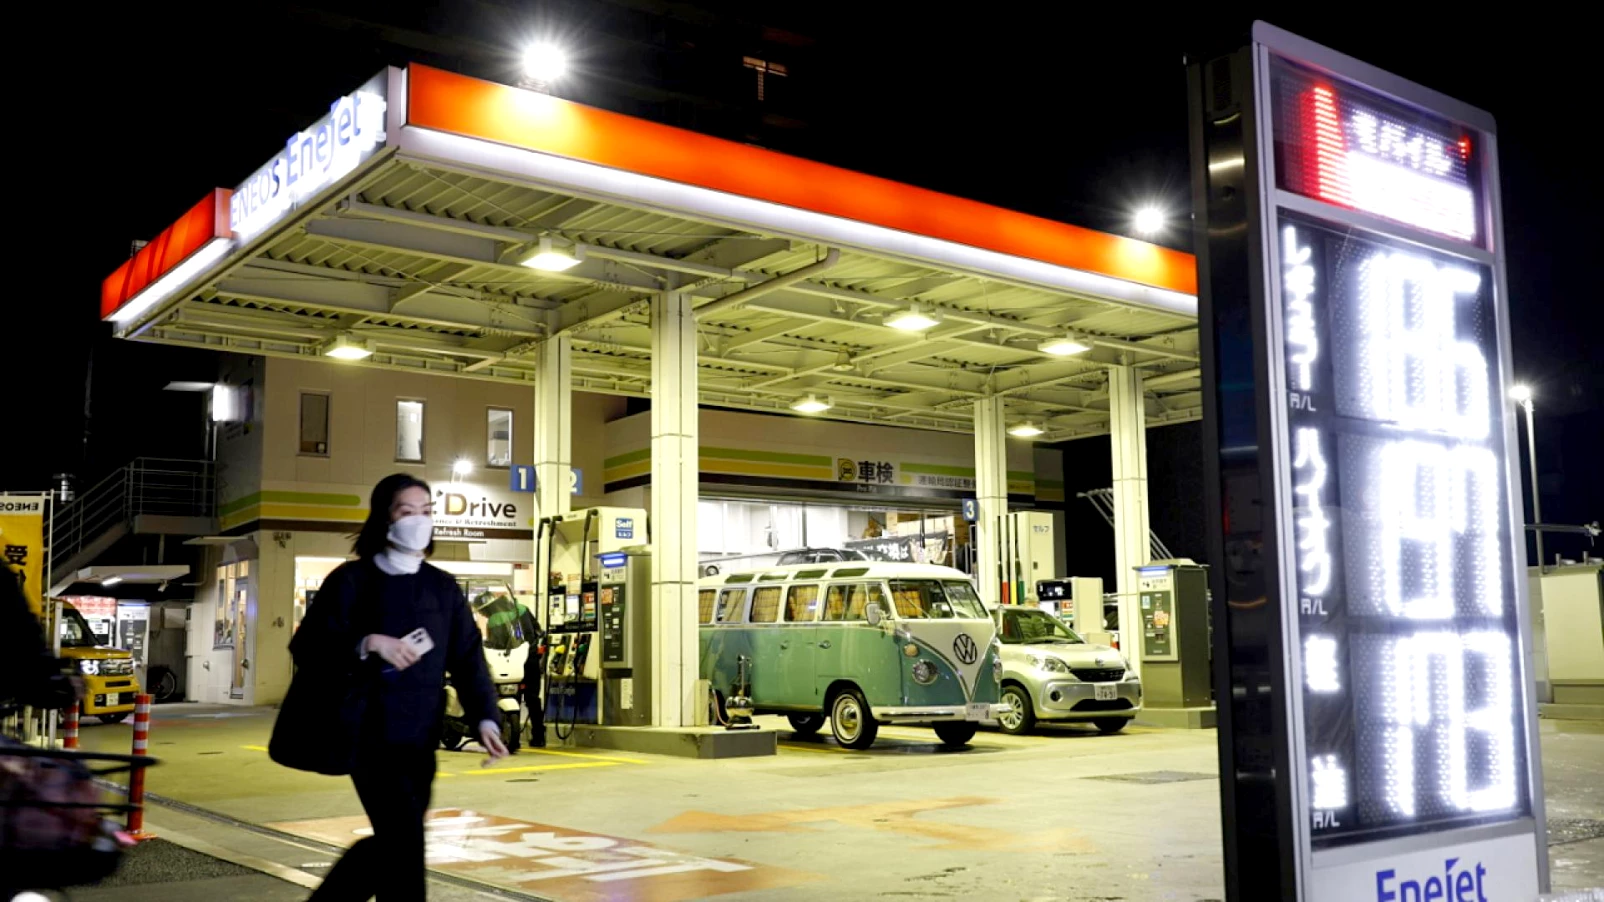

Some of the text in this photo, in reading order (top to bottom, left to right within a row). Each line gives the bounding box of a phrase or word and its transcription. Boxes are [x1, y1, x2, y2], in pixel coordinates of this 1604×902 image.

[230, 160, 280, 228] ENEOS
[517, 467, 527, 490] 1
[858, 461, 894, 484] 車検
[966, 500, 975, 519] 3
[1295, 428, 1330, 595] ハイオク
[434, 527, 485, 537] Refresh Room
[616, 519, 633, 528] Self
